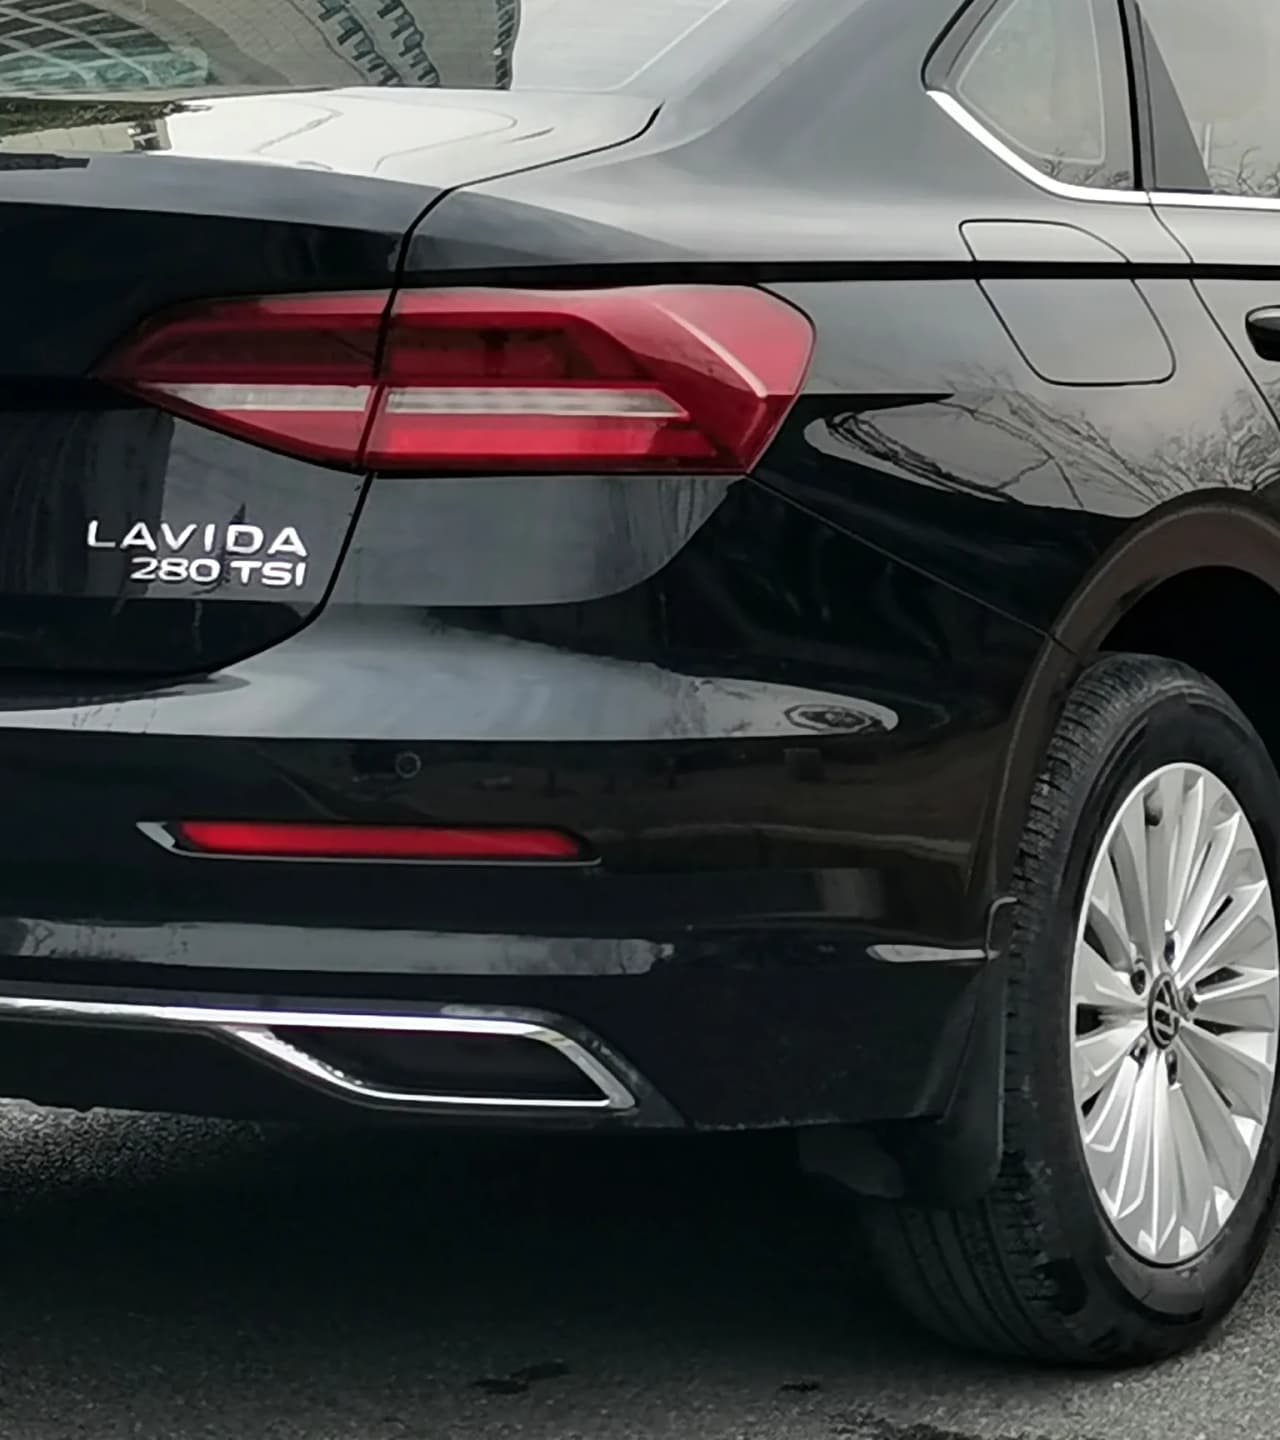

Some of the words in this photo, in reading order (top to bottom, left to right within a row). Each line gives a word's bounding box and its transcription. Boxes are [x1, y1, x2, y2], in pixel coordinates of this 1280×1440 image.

[86, 519, 308, 558] LAVIDA
[129, 557, 222, 583] 280
[229, 560, 307, 587] TSI
